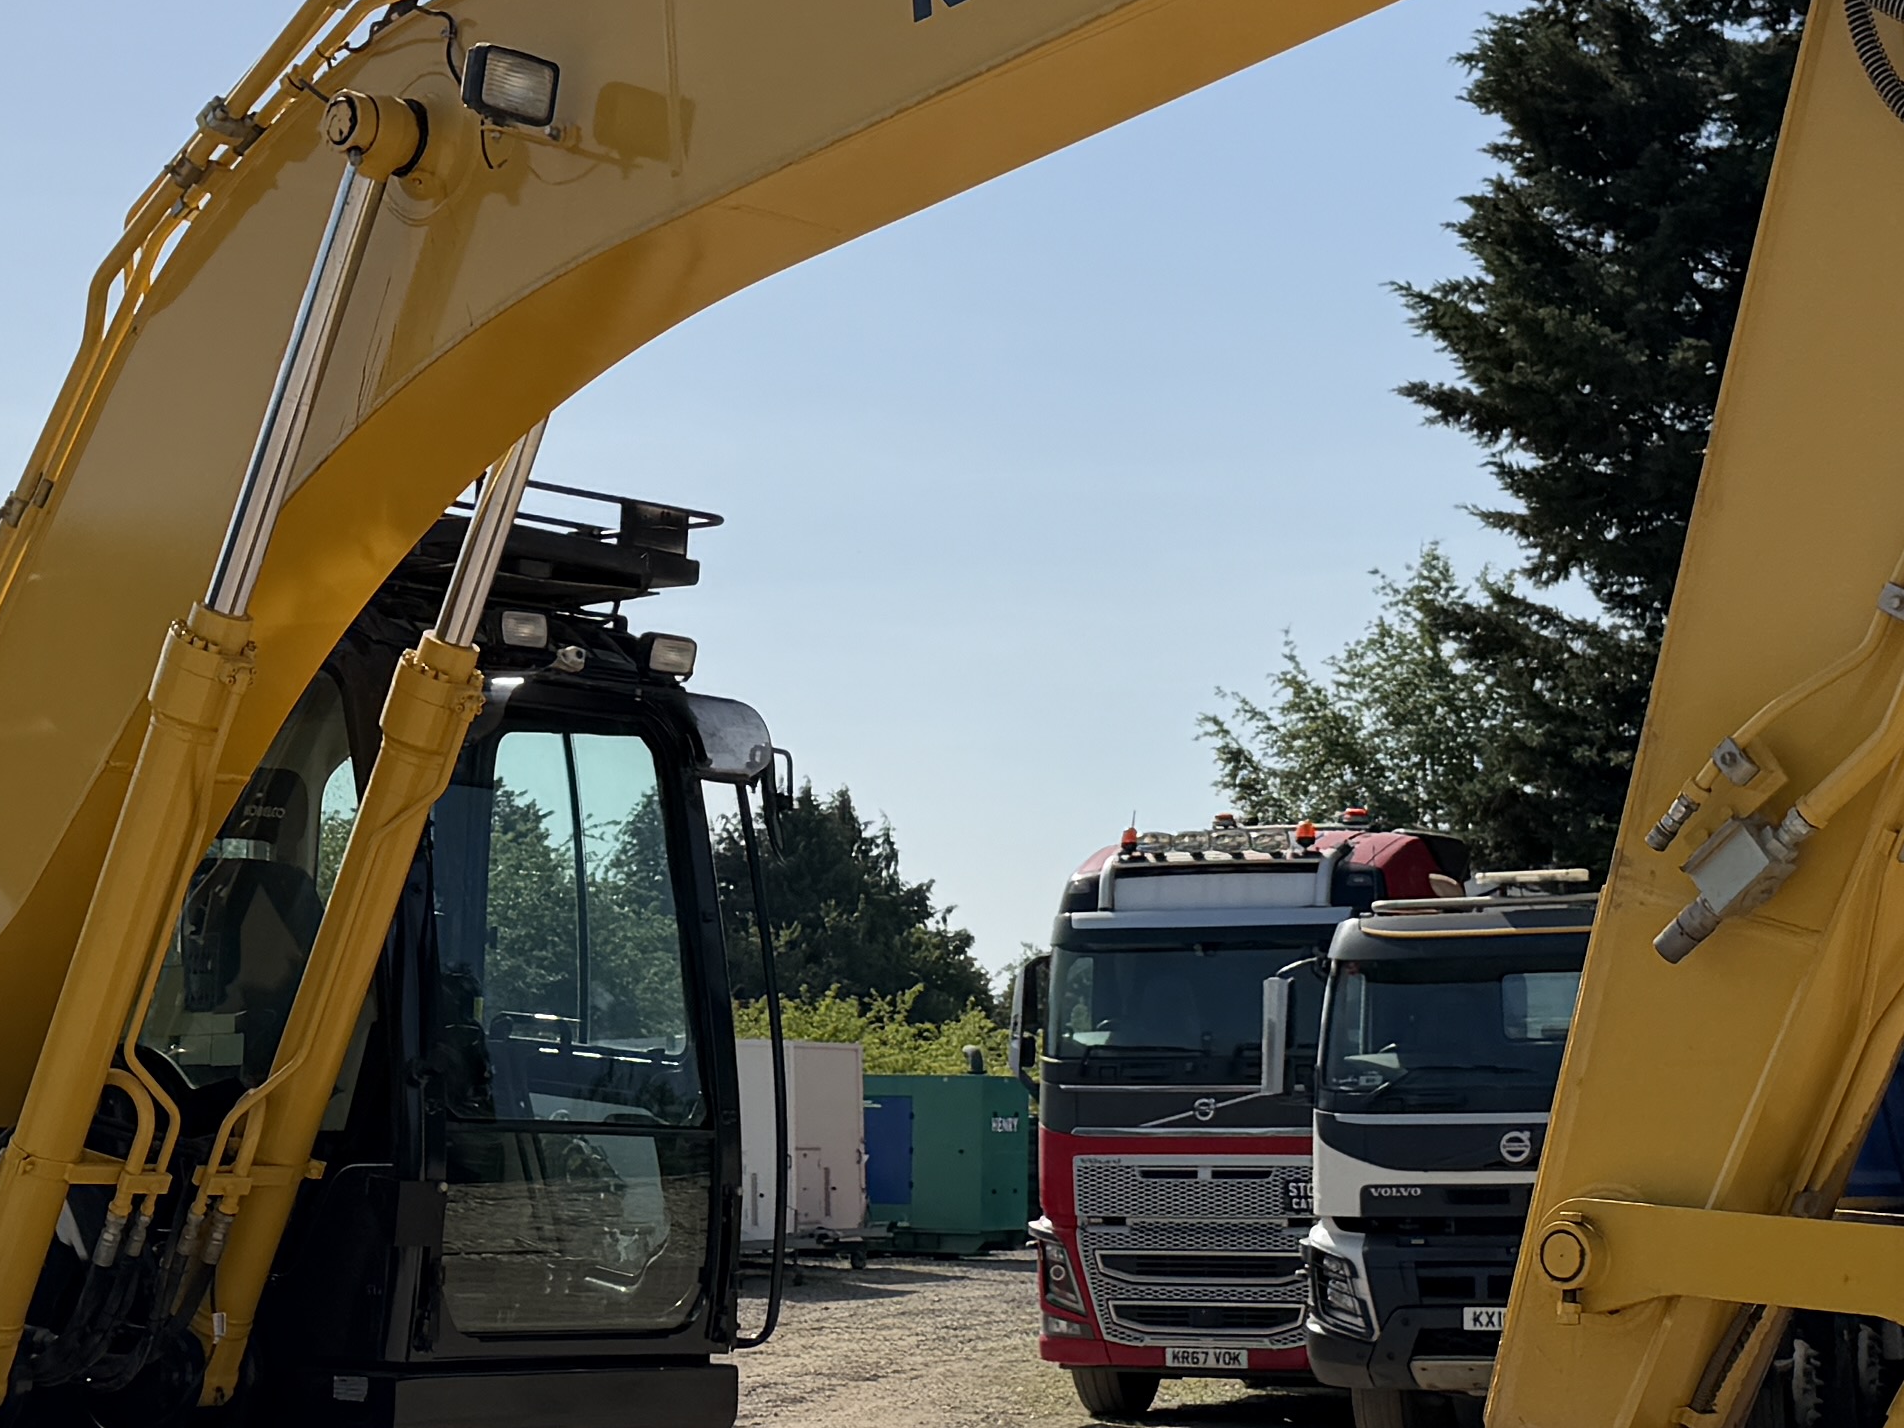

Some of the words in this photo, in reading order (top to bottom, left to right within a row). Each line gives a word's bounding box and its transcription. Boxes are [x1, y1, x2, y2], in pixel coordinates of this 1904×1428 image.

[1369, 1187, 1422, 1197] VOLVO
[1473, 1311, 1503, 1328] KX1
[1171, 1350, 1209, 1365] KR67
